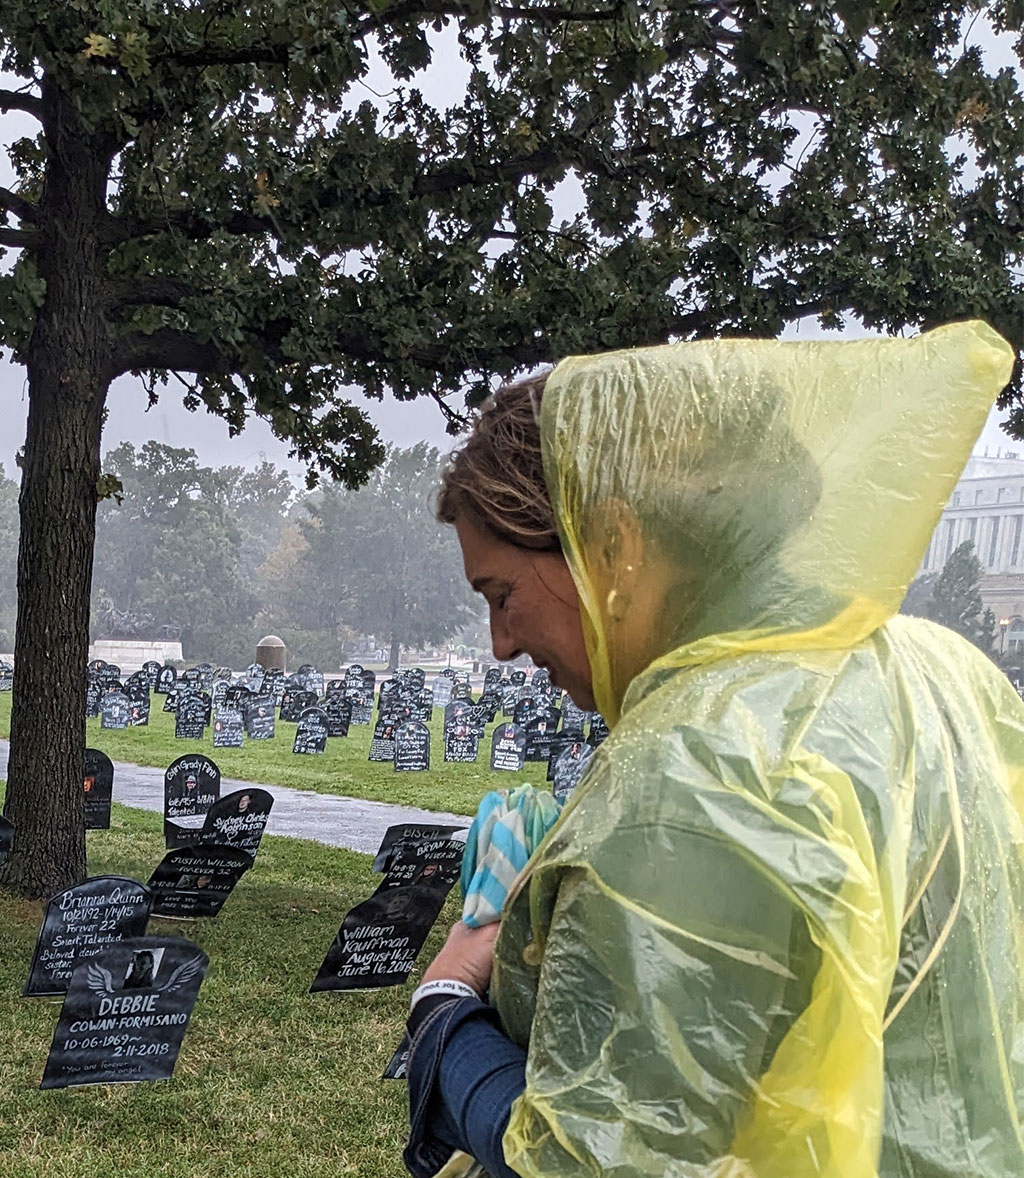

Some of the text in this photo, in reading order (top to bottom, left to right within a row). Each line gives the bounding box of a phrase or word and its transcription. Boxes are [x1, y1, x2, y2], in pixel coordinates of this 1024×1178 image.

[171, 857, 245, 868] JUSTIN WILSON
[59, 887, 144, 910] Brianna Quinn
[66, 920, 117, 934] Forever 22
[343, 925, 395, 941] William
[341, 936, 410, 953] Kauffman
[39, 948, 75, 961] Beloved
[346, 951, 392, 965] August
[337, 964, 371, 978] June
[98, 994, 160, 1017] DEBBIE
